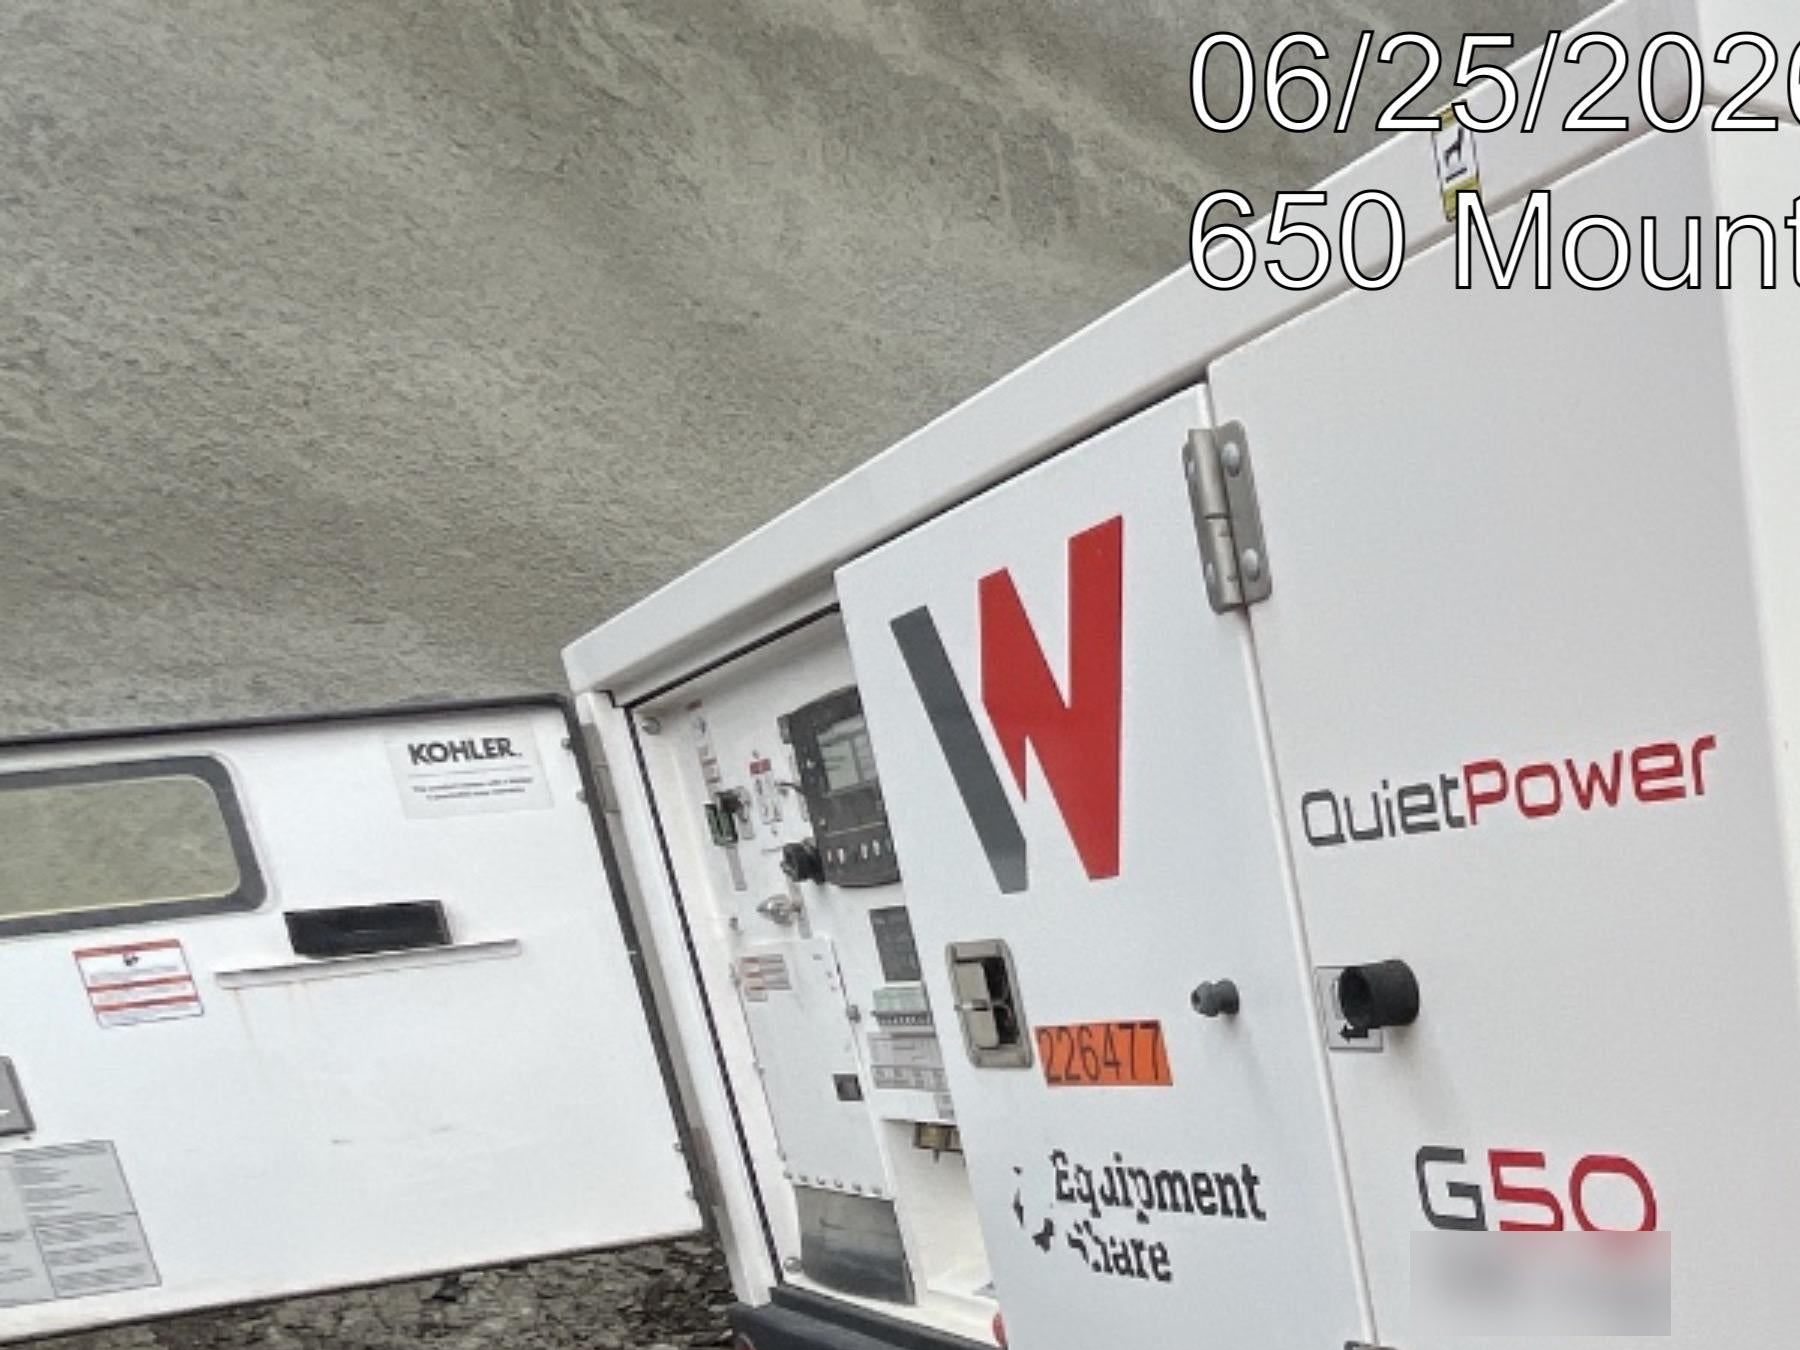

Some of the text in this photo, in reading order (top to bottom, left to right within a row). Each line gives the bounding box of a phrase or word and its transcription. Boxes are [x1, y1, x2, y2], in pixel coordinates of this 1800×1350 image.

[1300, 733, 1719, 848] QuietPower
[1037, 1022, 1168, 1081] 226477
[1049, 1148, 1267, 1224] Equipment
[1415, 1144, 1658, 1232] G50
